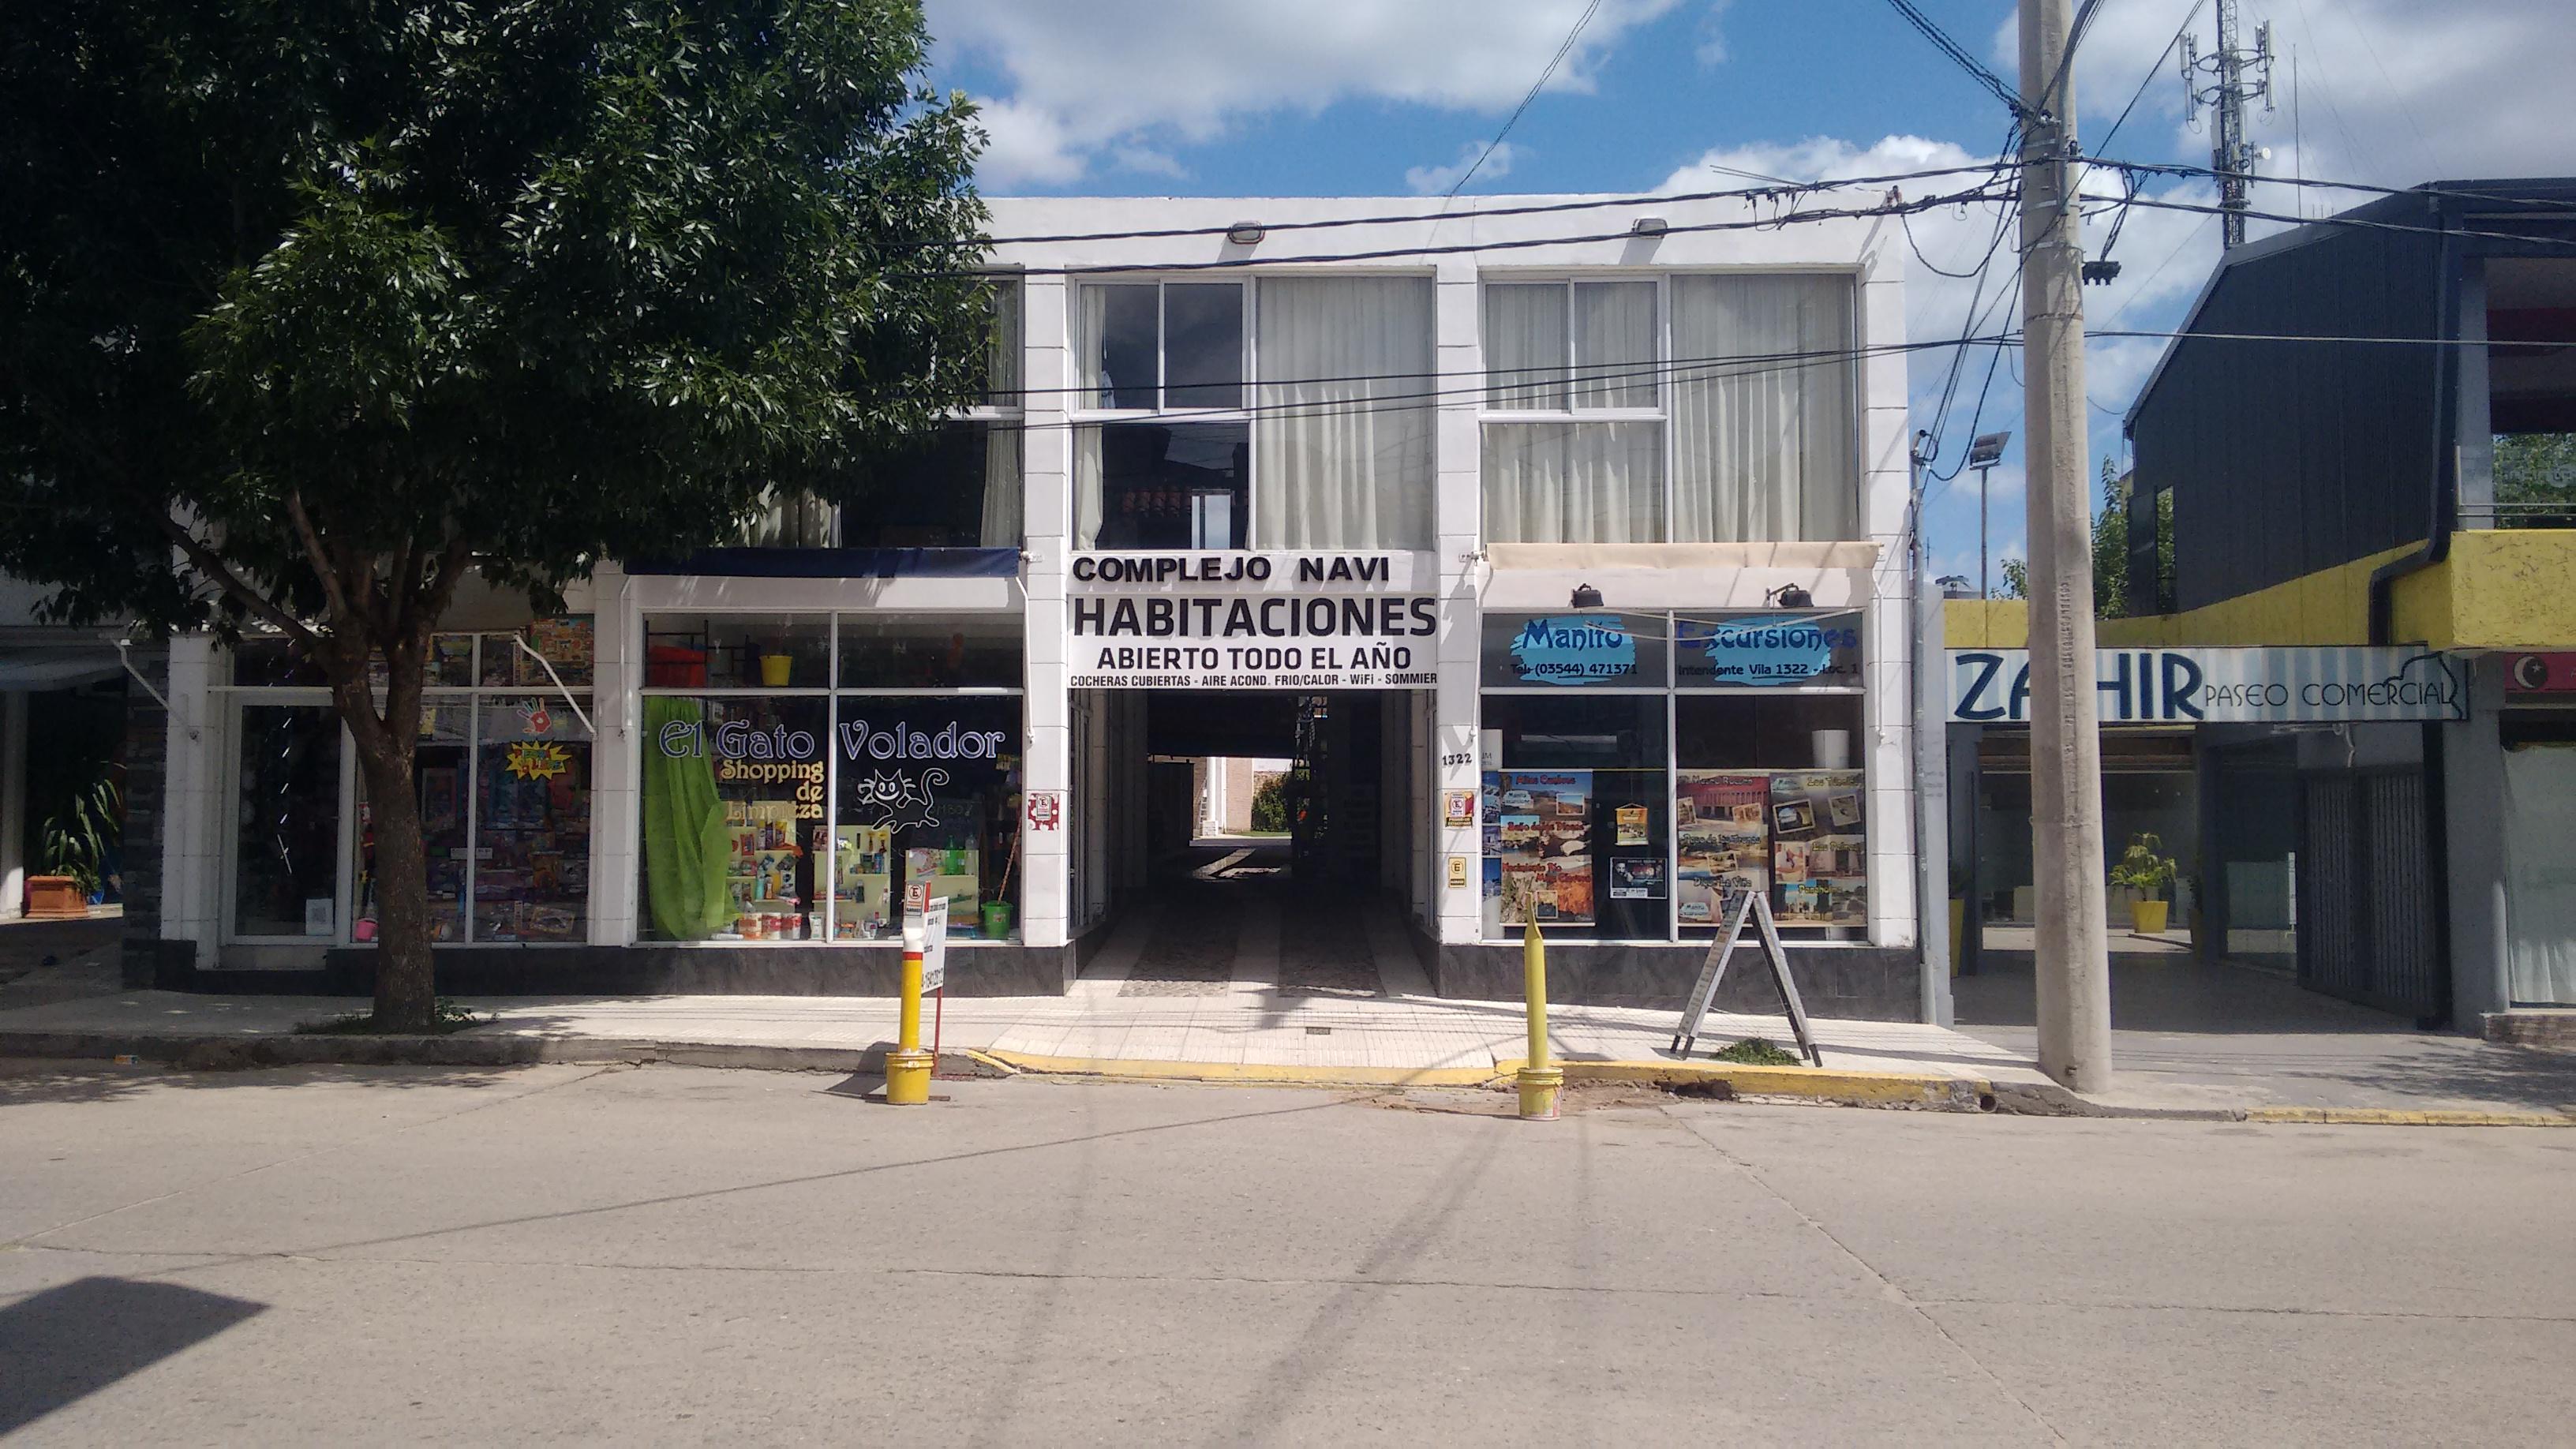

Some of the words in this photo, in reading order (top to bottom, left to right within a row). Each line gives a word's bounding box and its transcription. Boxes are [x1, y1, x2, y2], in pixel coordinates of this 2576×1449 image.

[1073, 556, 1271, 582] COMPLEJO
[1300, 556, 1389, 582] NAVI
[1074, 597, 1436, 637] HABITACIONES
[1097, 647, 1219, 670] ABIERTO
[1226, 647, 1302, 670] TODO
[1311, 647, 1343, 669] EL
[1350, 641, 1411, 669] AÑO
[1070, 676, 1128, 687] COCHERAS
[1131, 675, 1191, 687] CUBIERTAS
[1201, 675, 1226, 687] AIRE
[1275, 674, 1339, 686] FRIO/CALOR
[1350, 673, 1375, 685] WiFi
[1385, 672, 1437, 684] SOMMIER
[1535, 663, 1585, 676] (03544)
[1589, 663, 1638, 675] 471371
[1679, 665, 1744, 676] Intendente
[1748, 663, 1772, 675] Vila
[1776, 664, 1808, 674] 1322
[2205, 683, 2290, 707] PASEO
[2301, 681, 2452, 706] COMERCIAL
[659, 720, 705, 758] El
[717, 720, 815, 759] Gato
[839, 719, 1006, 760] Volador
[720, 759, 826, 784] Shopping
[1443, 753, 1473, 766] 1322
[796, 781, 824, 803] de
